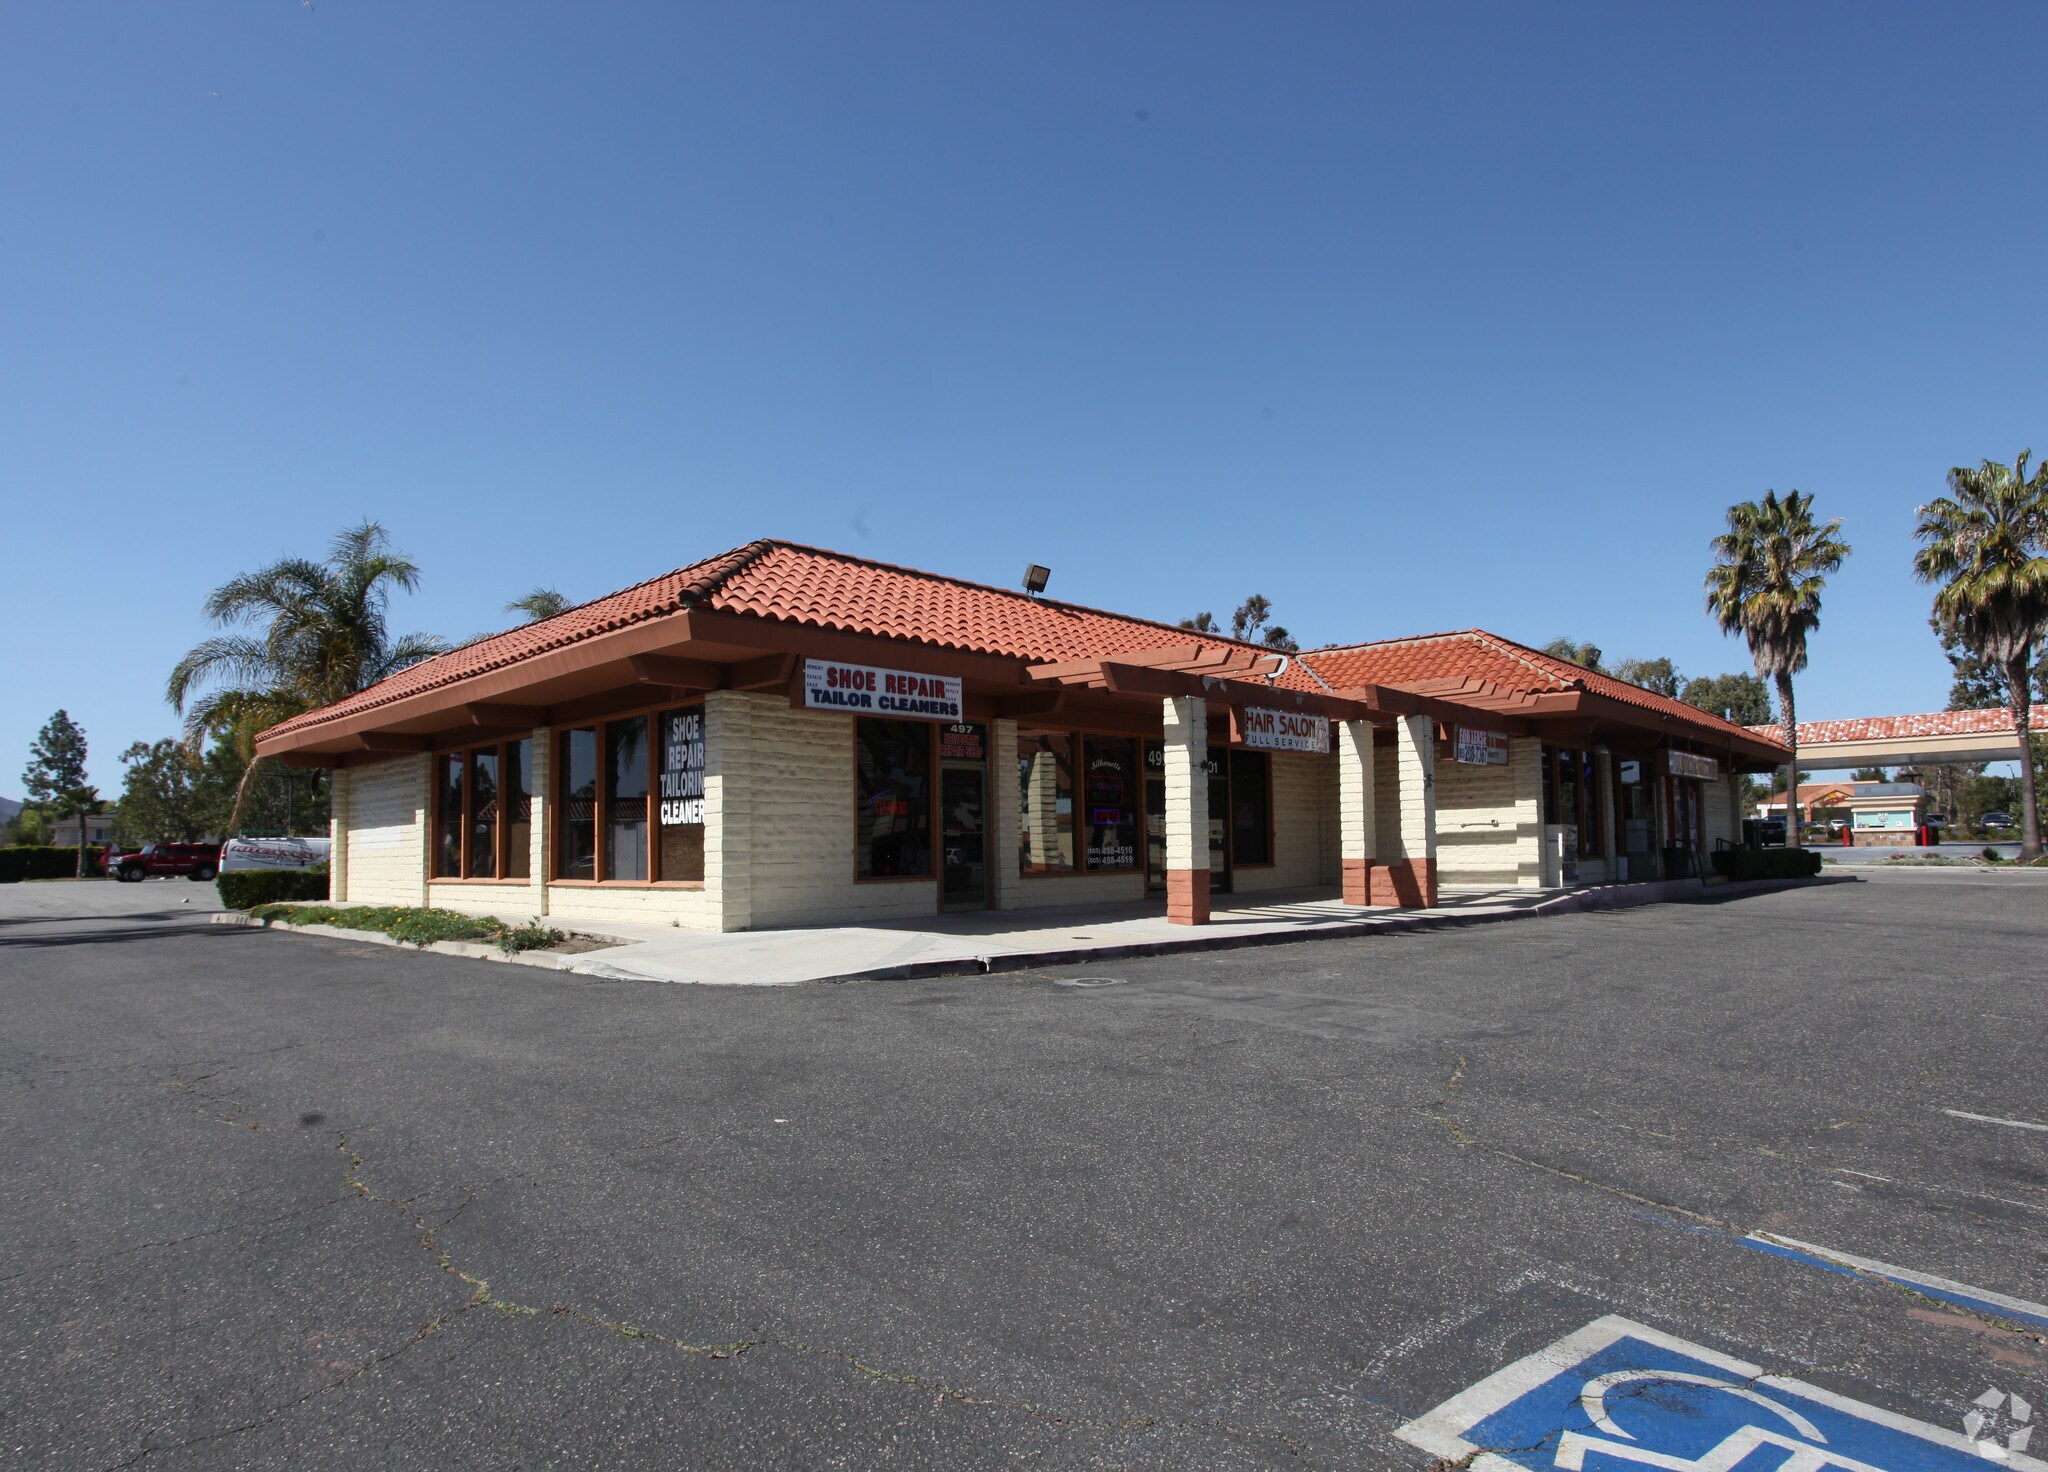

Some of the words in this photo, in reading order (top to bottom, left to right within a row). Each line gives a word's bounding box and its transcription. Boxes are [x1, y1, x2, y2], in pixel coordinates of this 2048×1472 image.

[827, 667, 877, 692] SHOE
[885, 673, 946, 699] REPAIR
[811, 689, 872, 708] TAILOR
[878, 696, 959, 716] CLEANERS
[672, 714, 699, 742] SHOE
[950, 724, 973, 734] 497
[1246, 711, 1275, 733] HAIR
[1279, 716, 1316, 738] SALON
[1459, 728, 1471, 744] FOR
[1471, 730, 1487, 746] LEASE
[668, 742, 704, 770] REPAIR
[1274, 737, 1316, 749] SERVICE
[1148, 750, 1165, 766] 49
